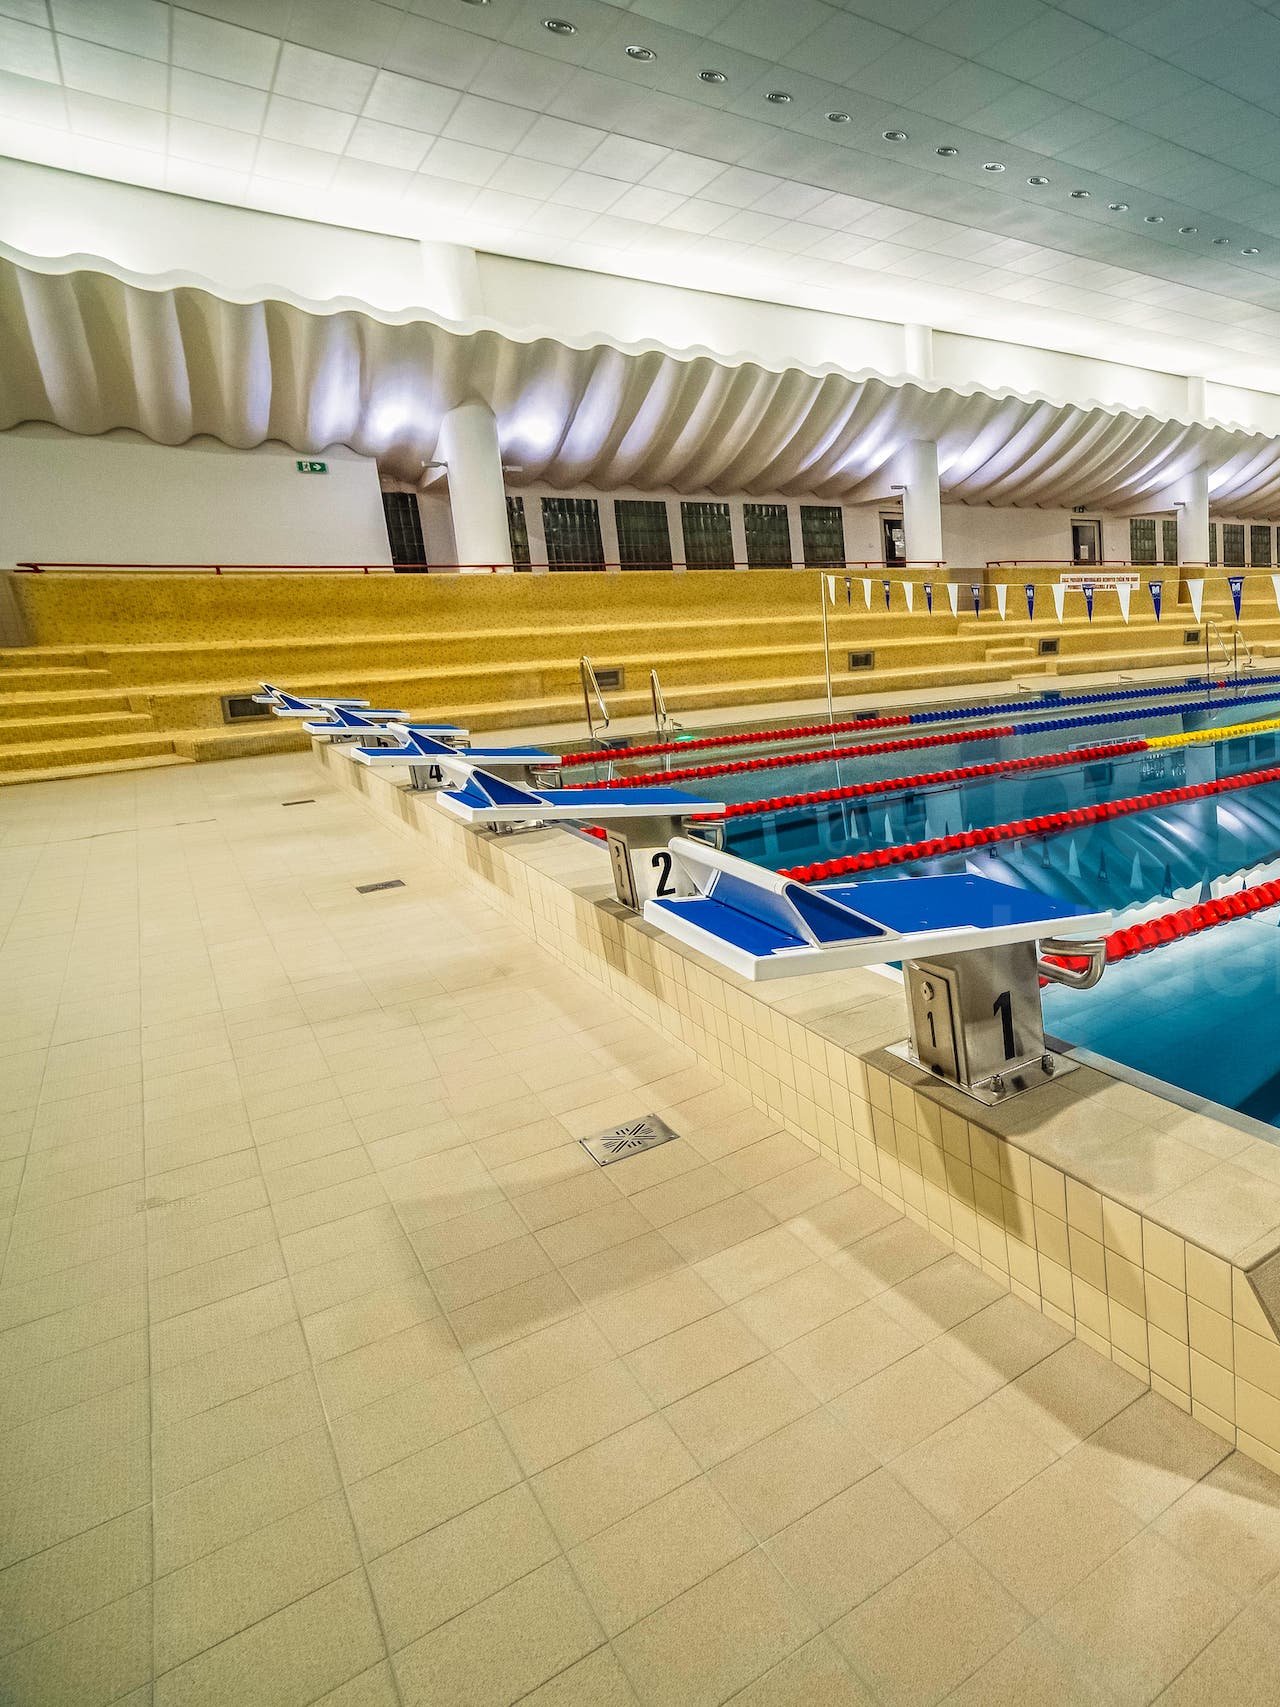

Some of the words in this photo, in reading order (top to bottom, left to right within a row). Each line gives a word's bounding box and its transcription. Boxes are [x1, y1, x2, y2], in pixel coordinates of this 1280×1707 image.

[651, 851, 676, 897] 2
[926, 1010, 937, 1048] 1
[993, 990, 1016, 1061] 1
